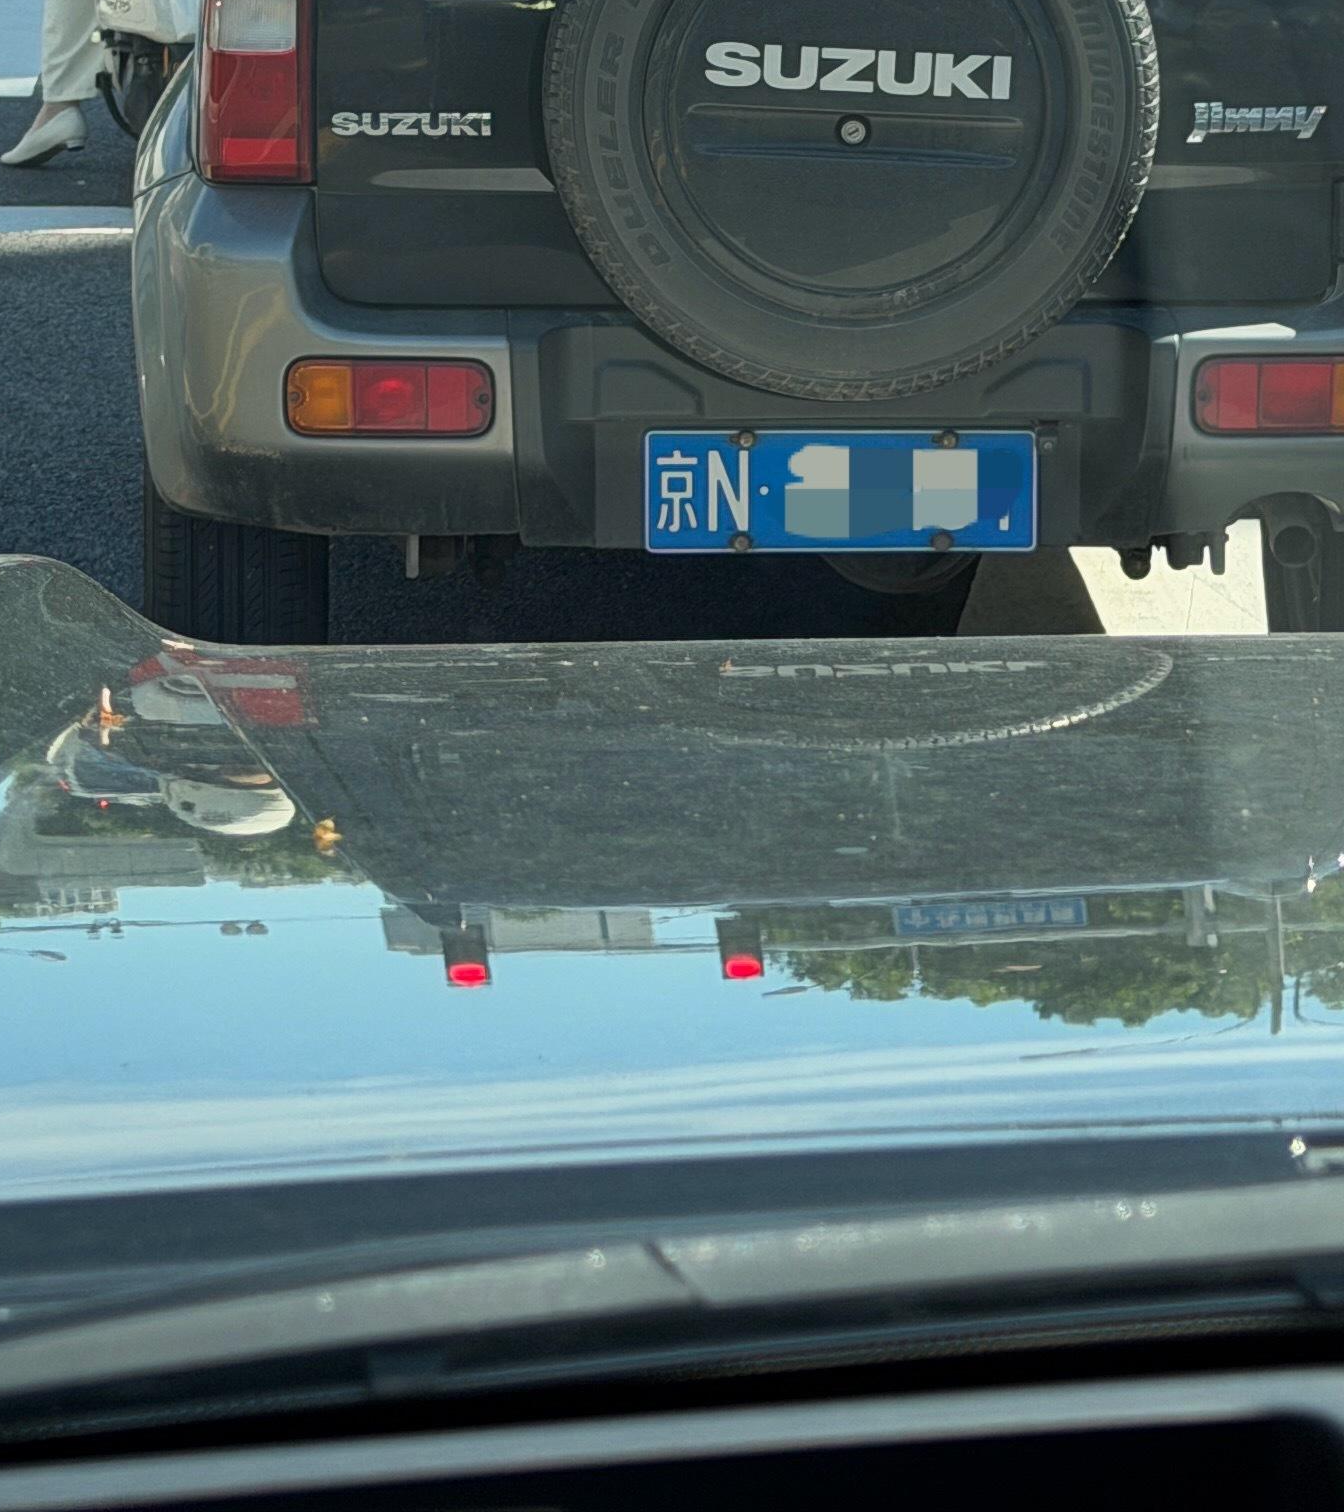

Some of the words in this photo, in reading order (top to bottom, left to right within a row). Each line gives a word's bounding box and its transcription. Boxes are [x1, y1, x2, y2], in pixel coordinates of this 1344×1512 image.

[704, 41, 1012, 100] SUZUKI
[331, 111, 492, 137] SUZUKI
[596, 32, 672, 266] DUELER
